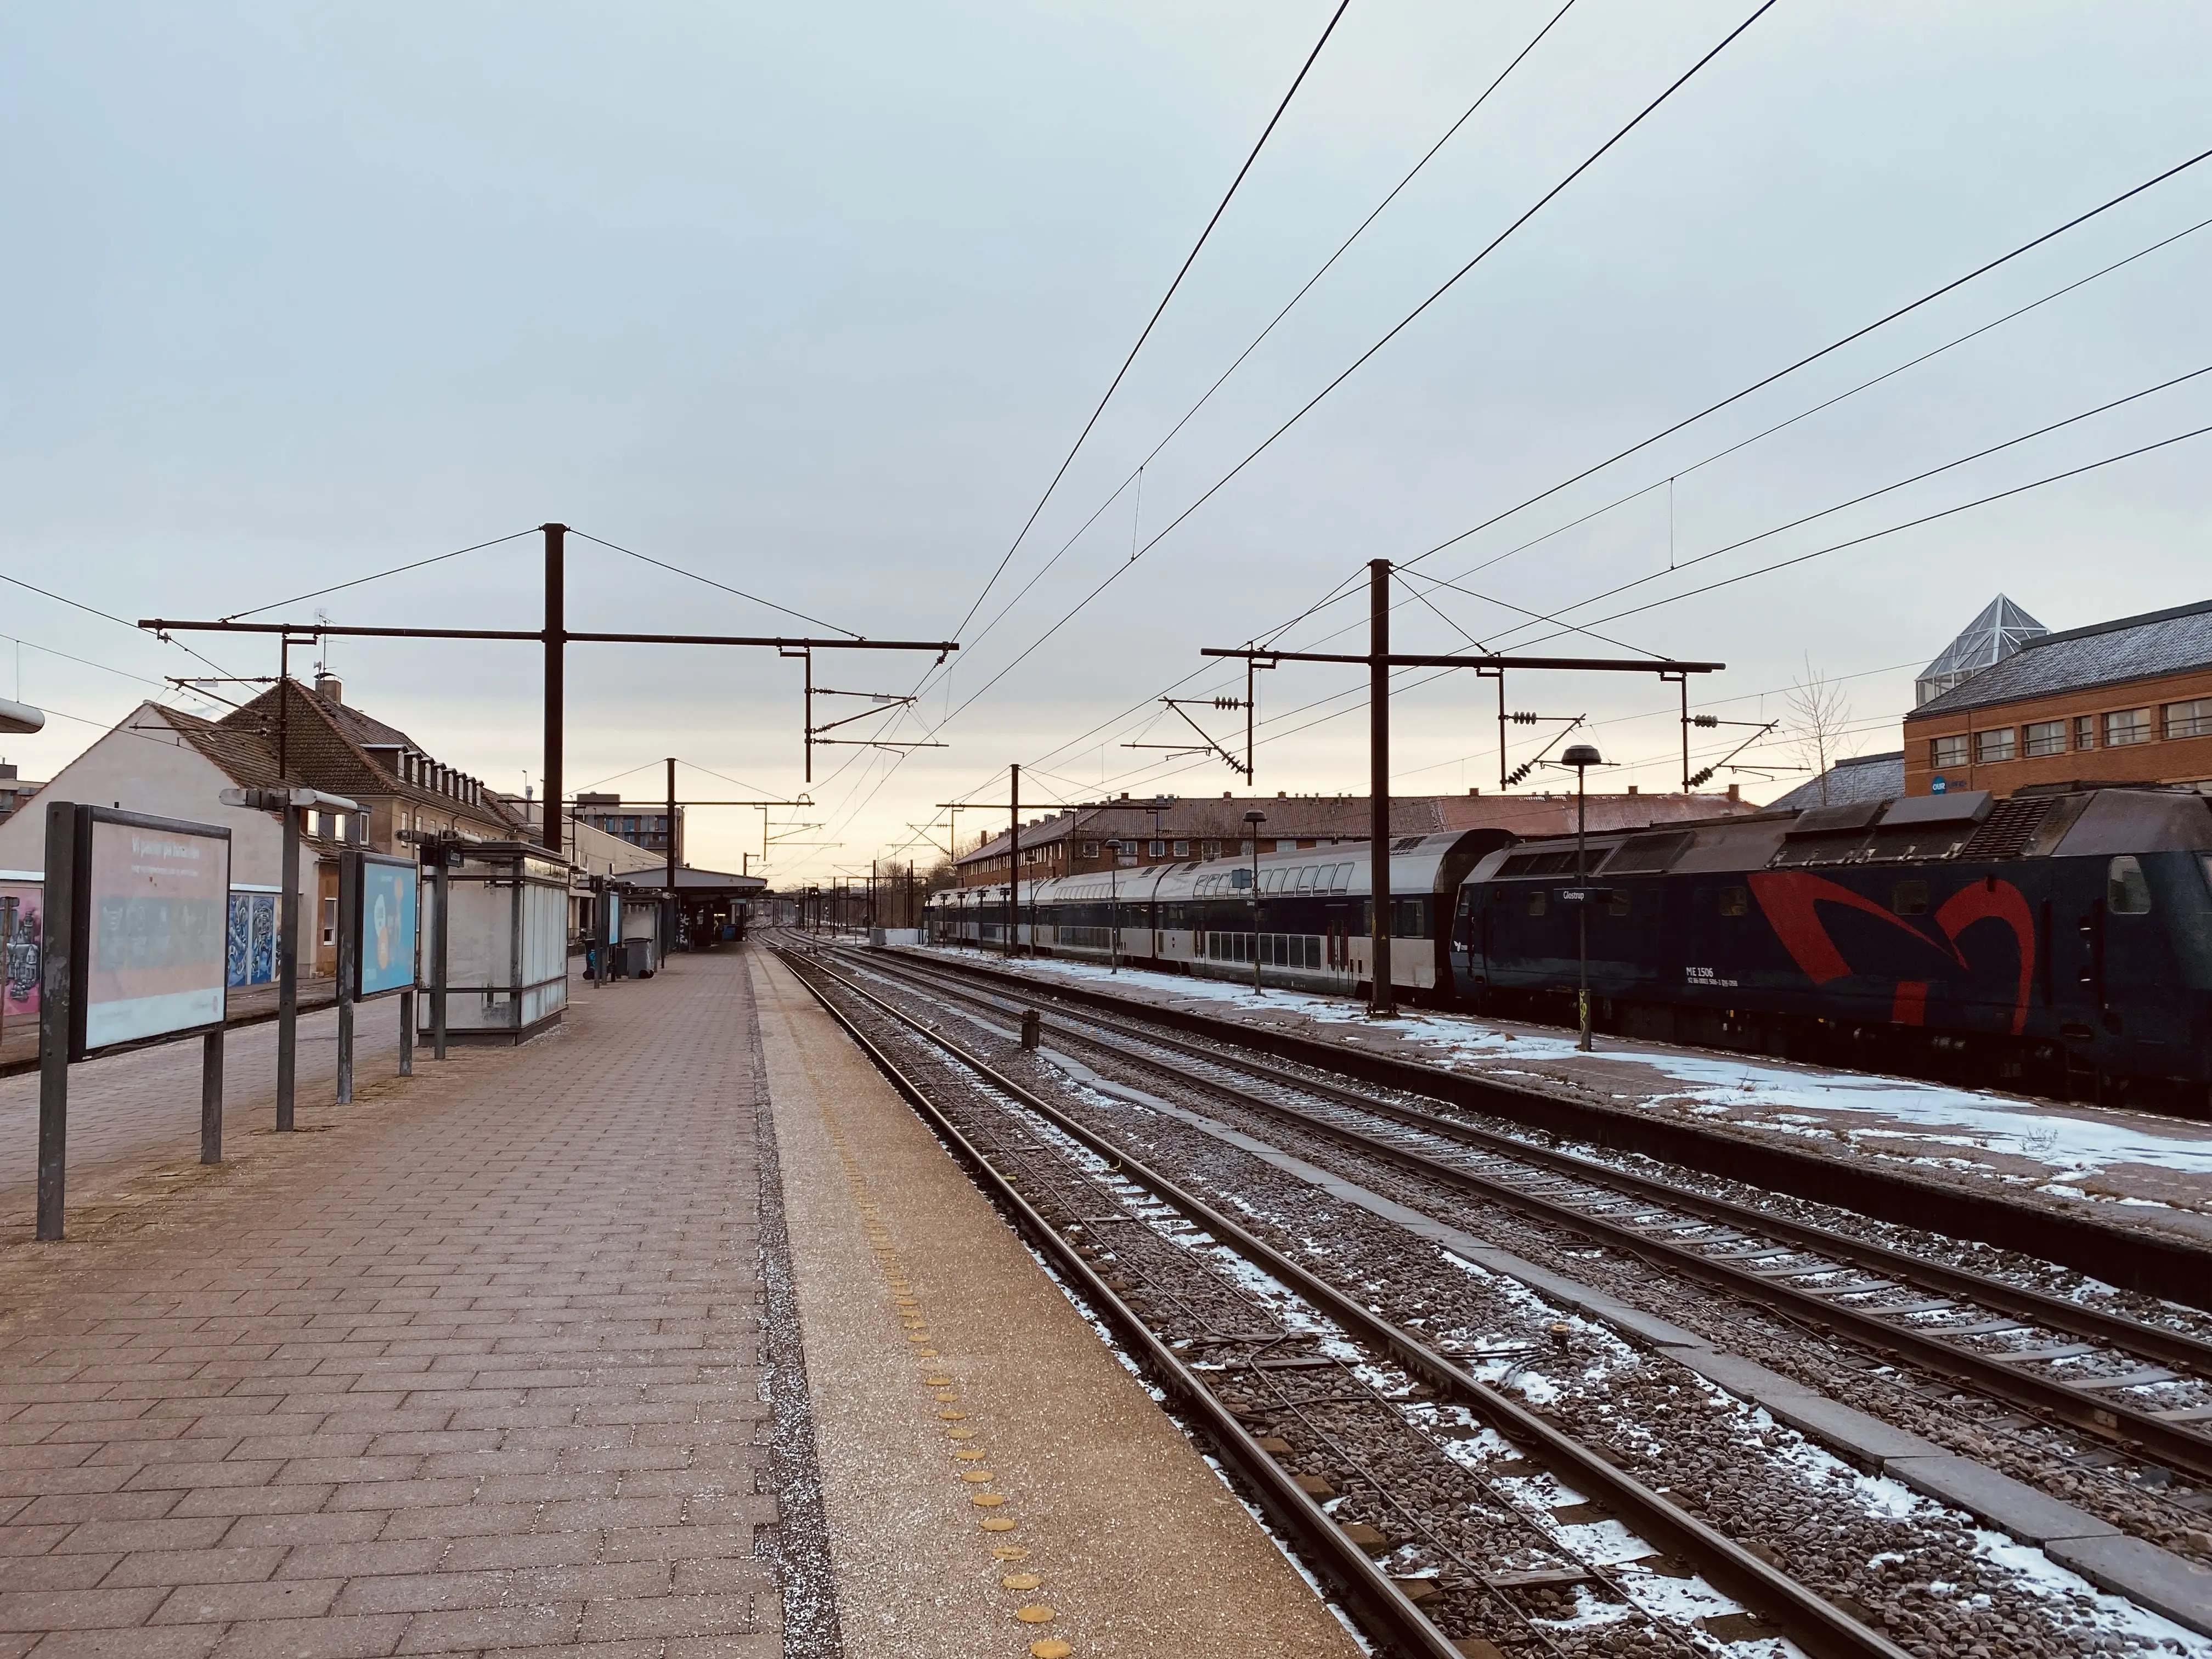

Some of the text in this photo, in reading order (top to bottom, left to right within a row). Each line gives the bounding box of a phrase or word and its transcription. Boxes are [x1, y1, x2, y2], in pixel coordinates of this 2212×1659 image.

[1563, 890, 1584, 901] Glostrup
[1686, 967, 1713, 977] ME 1506
